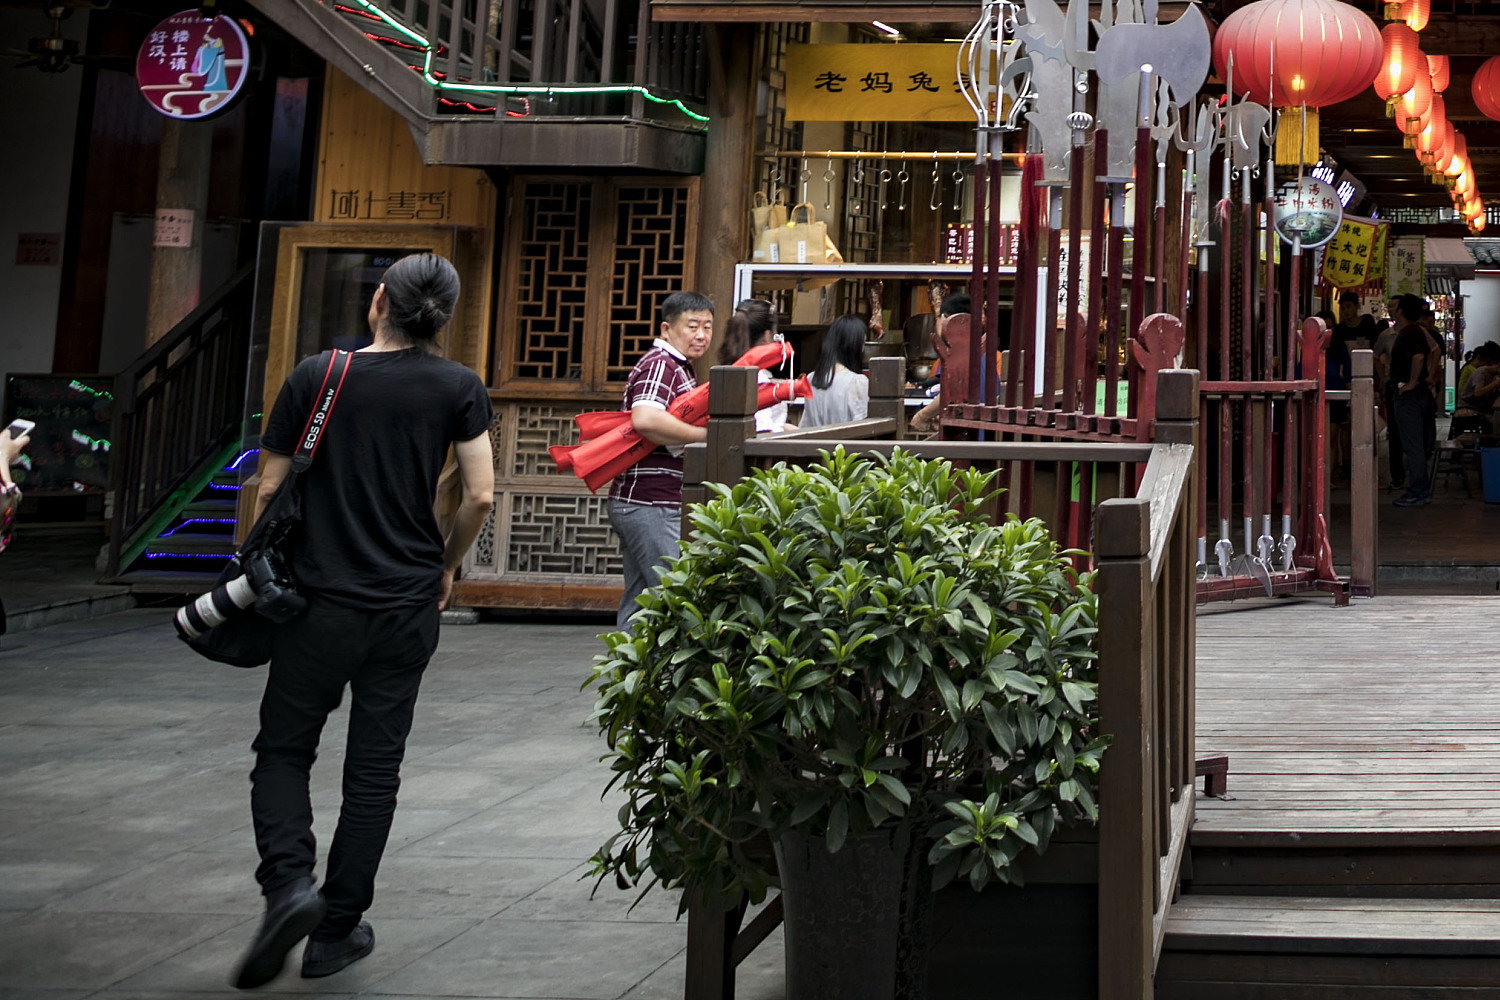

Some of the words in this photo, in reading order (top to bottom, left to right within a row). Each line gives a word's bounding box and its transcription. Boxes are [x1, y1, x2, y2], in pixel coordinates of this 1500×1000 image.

[1328, 238, 1367, 258] 三大炮
[304, 425, 320, 449] EOS
[314, 412, 325, 425] 5D
[321, 396, 332, 412] Mark
